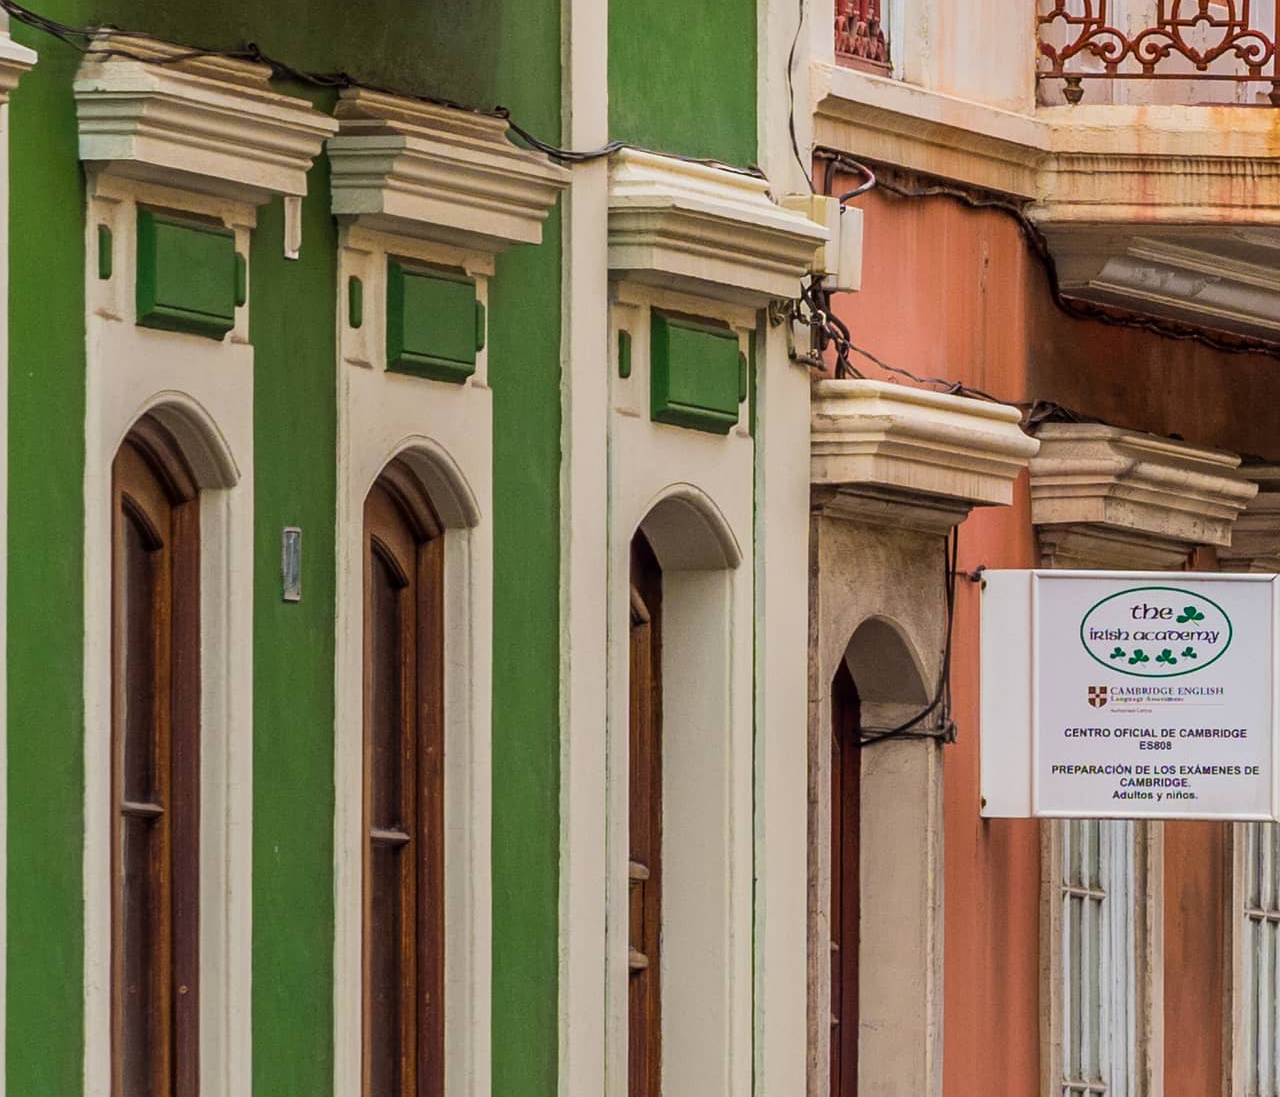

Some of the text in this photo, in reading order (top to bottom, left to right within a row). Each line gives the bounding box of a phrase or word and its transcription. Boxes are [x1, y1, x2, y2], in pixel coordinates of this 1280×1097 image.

[1130, 603, 1174, 620] the
[1133, 629, 1220, 644] academy
[1110, 686, 1224, 696] CAMBRIDGE ENGLISH
[1064, 728, 1247, 739] CENTRO OFICIAL DE CAMBRIDGE
[1139, 741, 1173, 751] ES808
[1051, 764, 1260, 776] PREPARACIÓN DE LOS EXÁMENES DE
[1119, 778, 1192, 788] CAMBRIDGE.
[1112, 790, 1199, 802] Adultos y niños.
